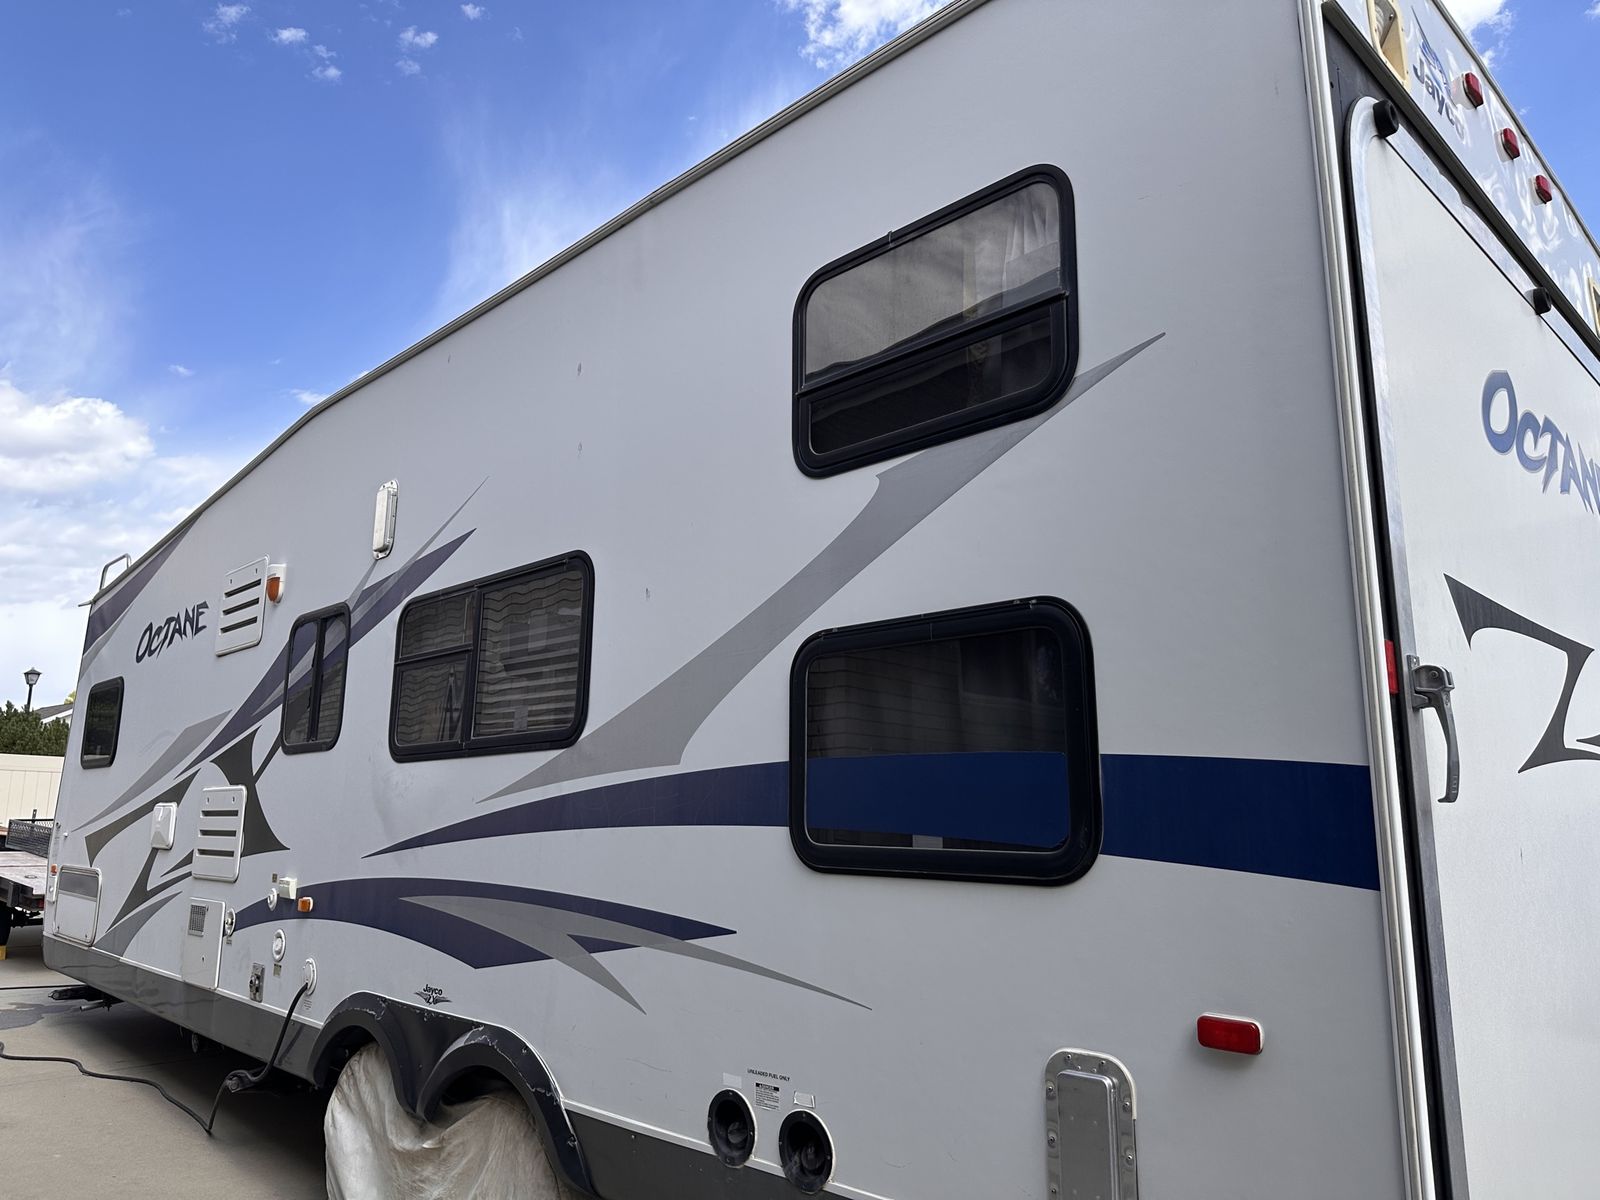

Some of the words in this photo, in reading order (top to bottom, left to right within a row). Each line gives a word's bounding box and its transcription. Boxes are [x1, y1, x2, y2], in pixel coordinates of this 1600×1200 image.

[1481, 369, 1600, 516] OCTAN
[136, 600, 209, 663] OCTANE
[422, 983, 443, 996] Jayco
[747, 1068, 769, 1077] UNLEADED
[769, 1072, 779, 1080] FUEL
